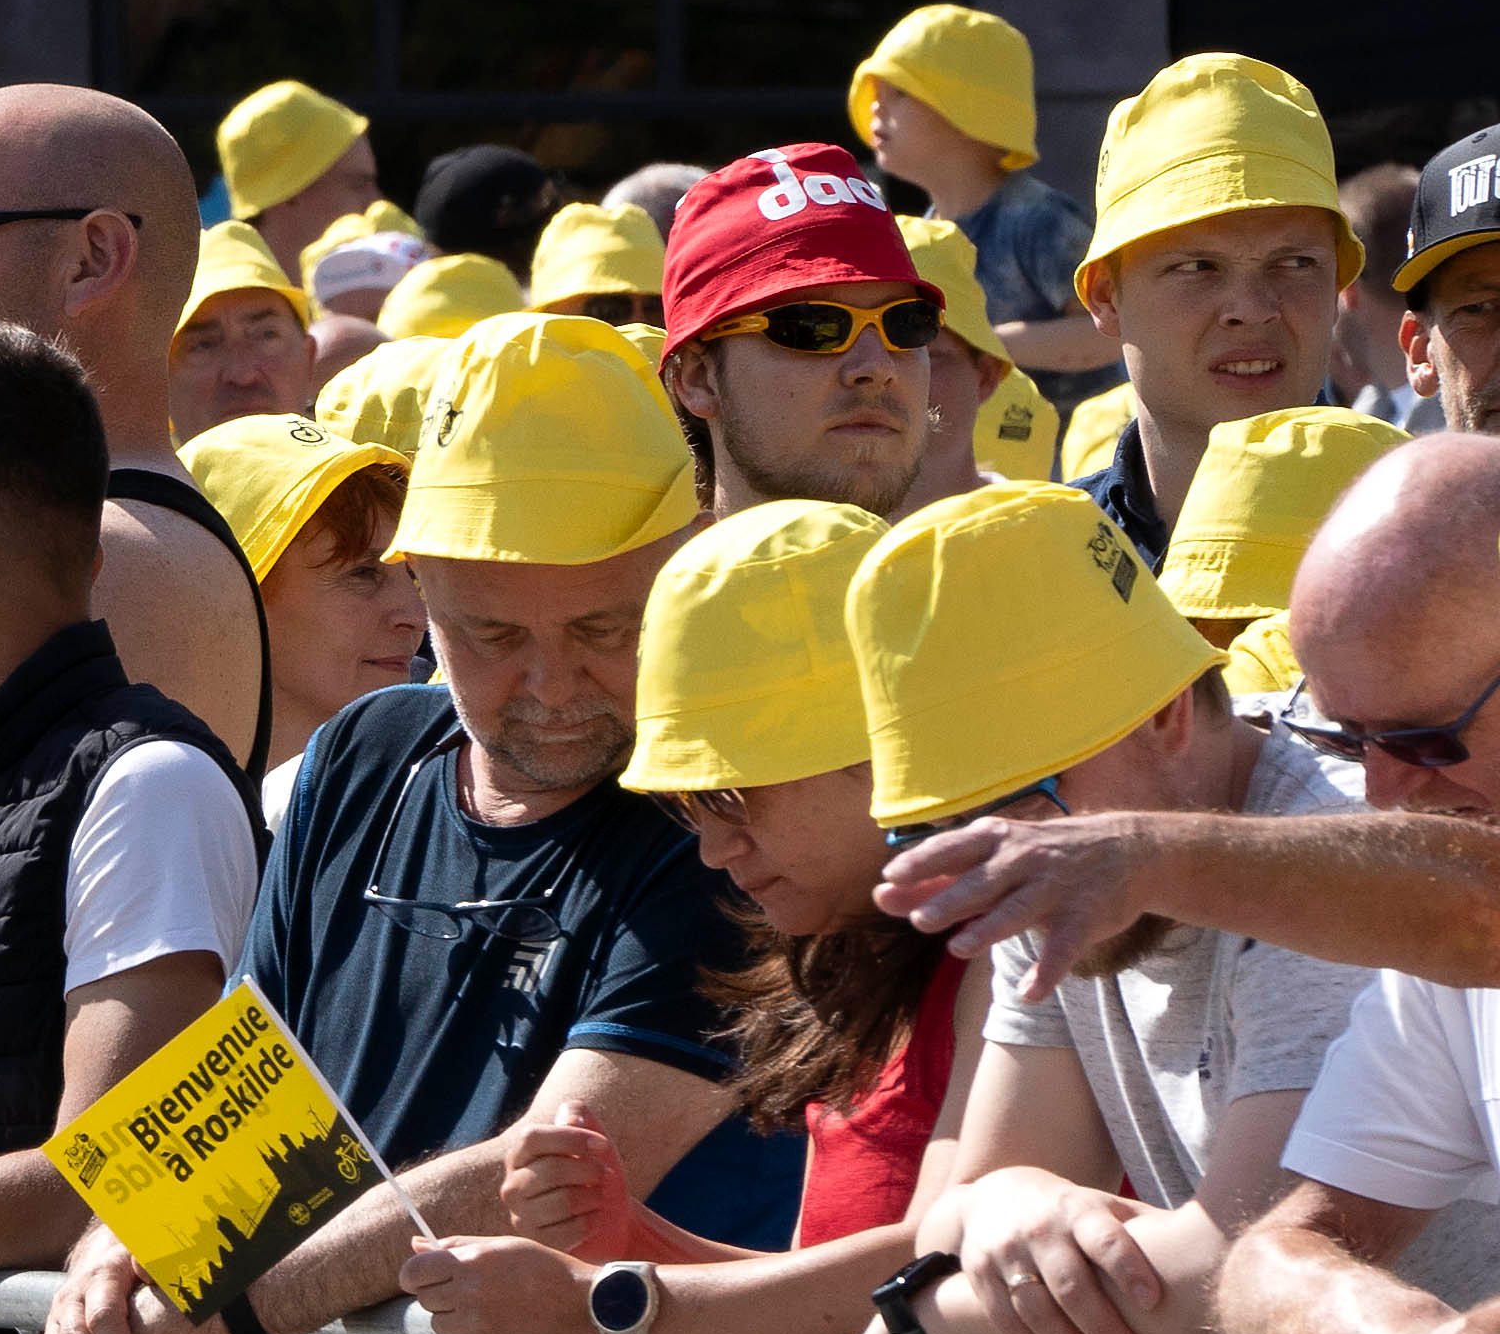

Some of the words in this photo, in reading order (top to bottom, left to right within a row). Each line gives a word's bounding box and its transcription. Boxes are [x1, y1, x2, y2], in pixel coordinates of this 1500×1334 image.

[127, 1005, 270, 1155] Bienvenue
[160, 1151, 195, 1183] à
[182, 1043, 295, 1162] Roskilde
